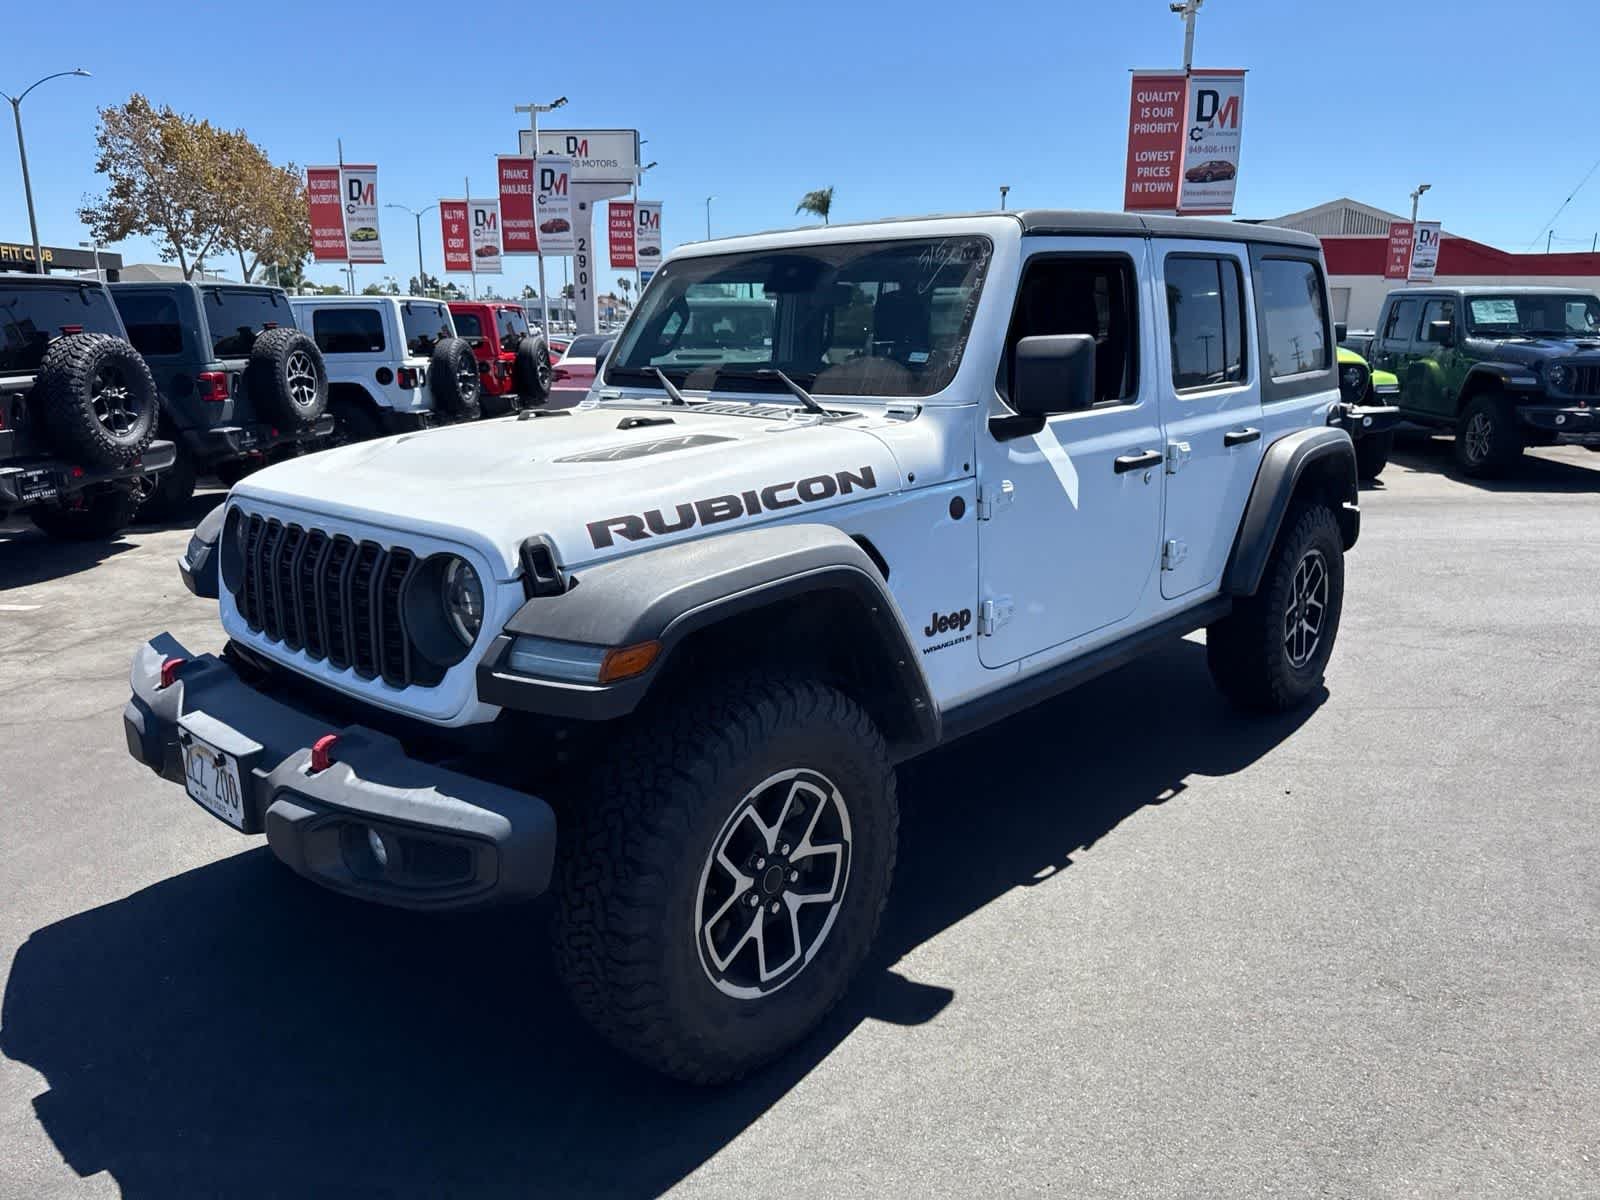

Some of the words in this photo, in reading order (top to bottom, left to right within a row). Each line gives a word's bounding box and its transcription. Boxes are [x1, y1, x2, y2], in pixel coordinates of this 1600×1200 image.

[1137, 91, 1180, 104] QUALITY
[1141, 107, 1150, 118] IS
[1152, 107, 1173, 118] OUR
[1196, 90, 1239, 128] DM
[1134, 122, 1179, 134] PRIORITY
[566, 136, 588, 158] DM
[1135, 151, 1175, 162] LOWEST
[582, 160, 618, 168] MOTORS
[503, 169, 528, 179] FINANCE
[1137, 167, 1170, 177] PRICES
[541, 168, 568, 195] DM
[1132, 182, 1142, 192] IN
[1145, 182, 1173, 193] TOWN
[348, 179, 375, 205] DM
[501, 184, 532, 194] AVAILABLE
[444, 210, 452, 220] ALL
[453, 210, 464, 220] TYPE
[475, 209, 497, 230] DM
[640, 210, 659, 229] DM
[451, 224, 459, 234] OF
[611, 231, 632, 239] TRUCKS
[448, 238, 464, 248] CREDIT
[1420, 229, 1438, 247] DM
[1, 246, 20, 260] FIT
[446, 253, 469, 262] WELCOME
[578, 238, 587, 300] 2901
[586, 465, 877, 550] RUBICON
[925, 608, 971, 637] Jeep
[922, 636, 965, 655] WRANGLER
